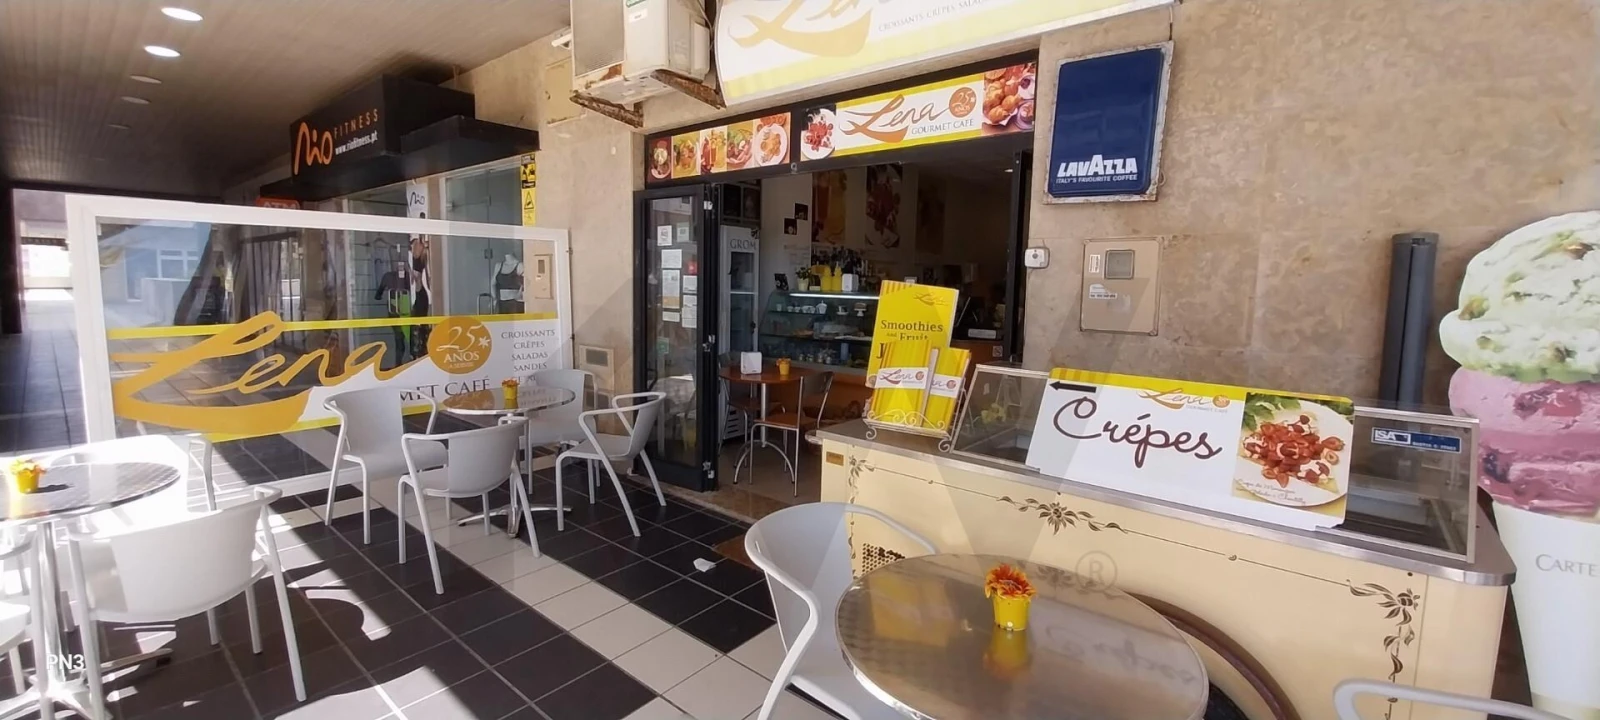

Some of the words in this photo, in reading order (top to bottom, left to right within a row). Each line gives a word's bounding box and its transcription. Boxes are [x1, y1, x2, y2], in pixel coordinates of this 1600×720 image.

[334, 108, 378, 139] FITNESS
[839, 94, 949, 144] Lena
[911, 122, 951, 135] GOURMET
[1078, 175, 1111, 183] FAVOURITE
[1112, 174, 1138, 182] COFFEE
[730, 239, 757, 250] GROM
[881, 319, 944, 332] Smoothies
[436, 325, 483, 352] 25
[501, 328, 556, 340] CROISSANTS
[900, 332, 929, 341] Fruit
[513, 340, 545, 350] CRÊPES
[443, 350, 480, 364] ANOS
[511, 350, 549, 361] SALADAS
[110, 310, 431, 435] Lena
[513, 362, 548, 373] SANDES
[444, 376, 490, 397] CAFÉ
[1136, 388, 1212, 409] Lena
[1374, 430, 1396, 441] ISA
